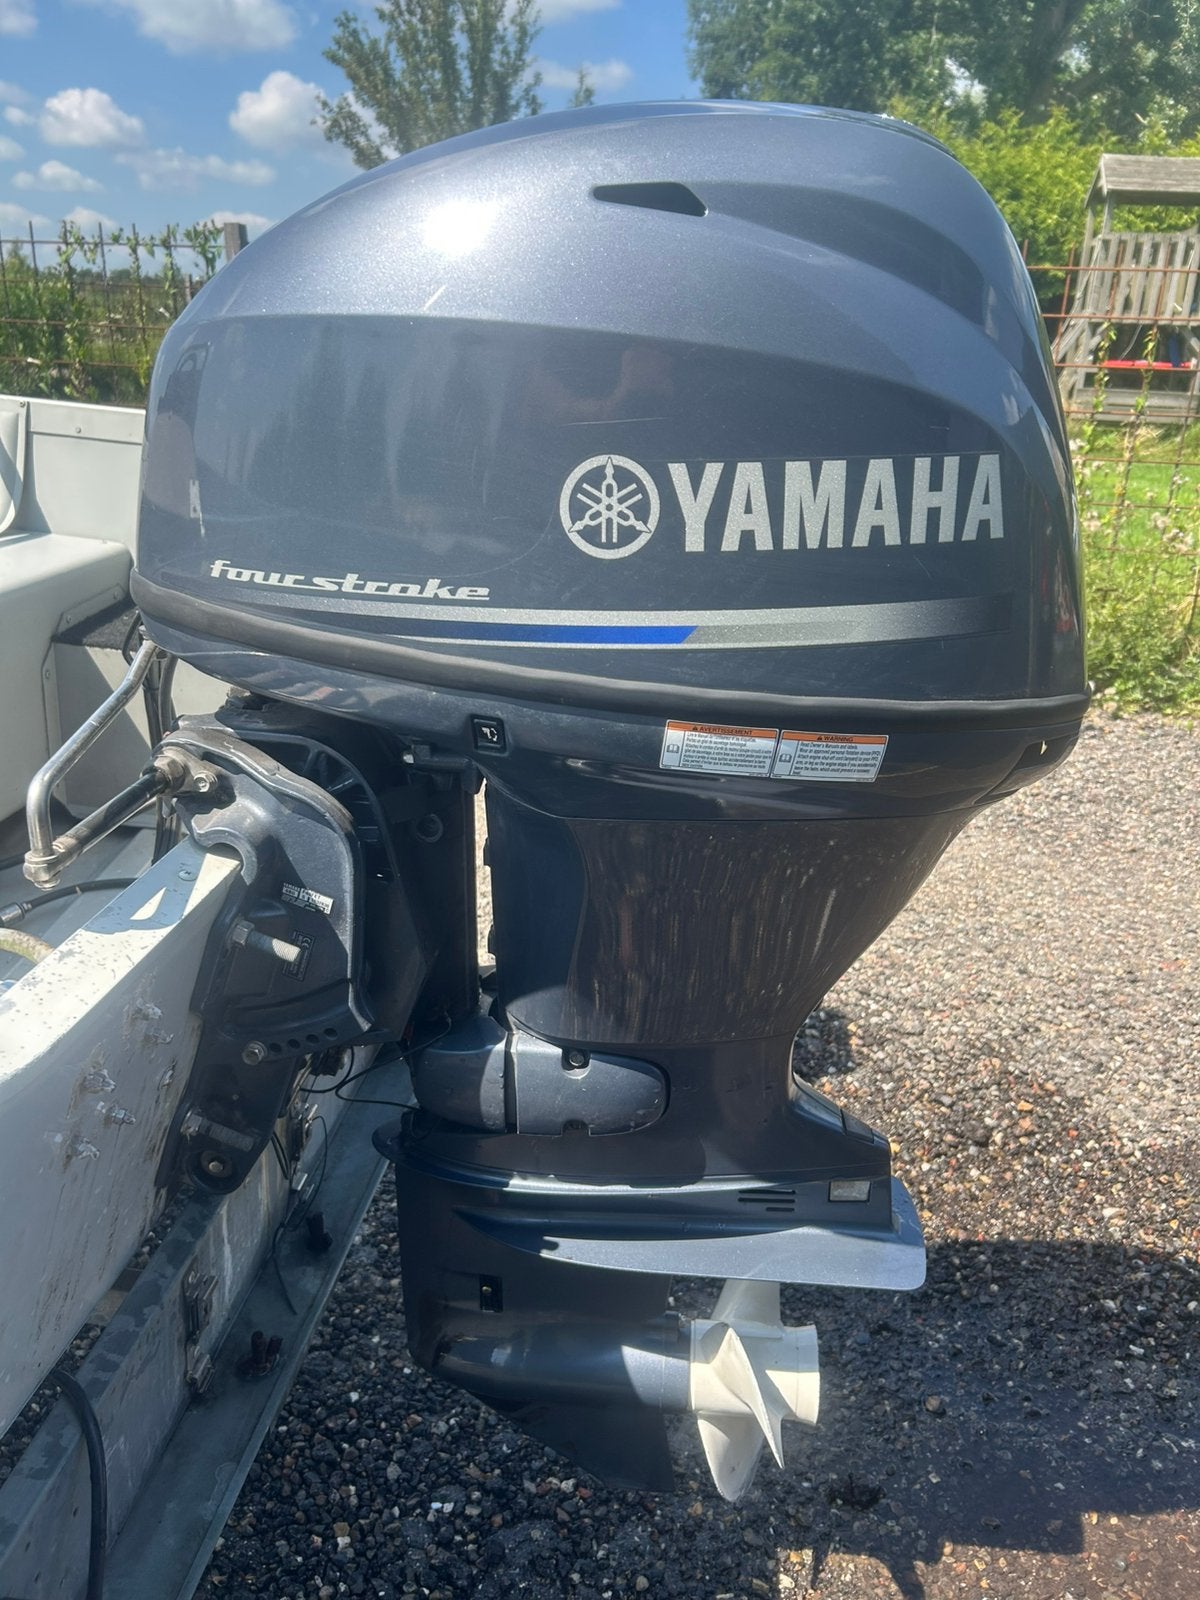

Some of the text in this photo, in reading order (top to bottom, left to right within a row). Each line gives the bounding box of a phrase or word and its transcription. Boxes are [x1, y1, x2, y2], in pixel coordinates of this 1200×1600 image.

[667, 454, 1005, 553] YAMAHA
[210, 559, 491, 601] four stroke
[700, 726, 753, 736] AVERTISSEMENT
